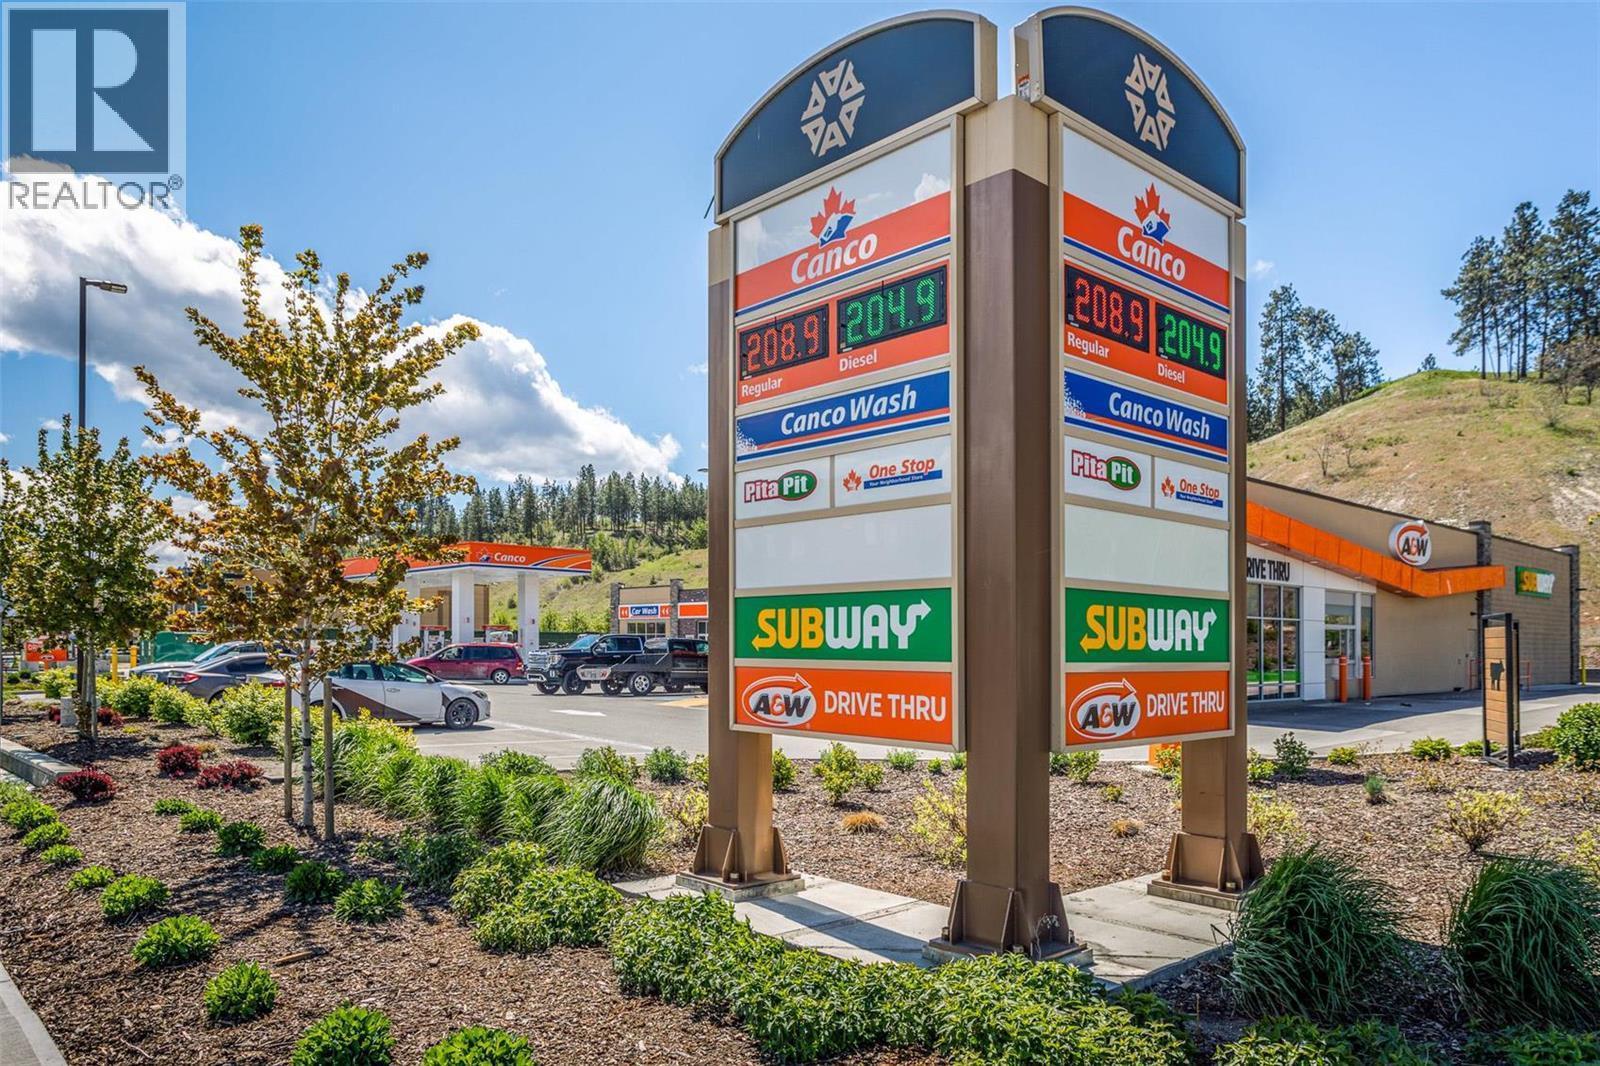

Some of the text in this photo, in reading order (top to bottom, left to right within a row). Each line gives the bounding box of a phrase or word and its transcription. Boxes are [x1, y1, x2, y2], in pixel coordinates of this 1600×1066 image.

[791, 233, 878, 285] Canco
[1117, 226, 1186, 282] Canco
[846, 277, 936, 344] 204.9
[1075, 278, 1144, 343] 208.9
[747, 314, 819, 371] 208.9
[1067, 331, 1110, 359] Regular
[1164, 313, 1221, 371] 204.9
[839, 349, 878, 372] Diesel
[1158, 363, 1185, 384] Diesel
[741, 376, 783, 398] Regular
[781, 384, 917, 436] Canco Wash
[1109, 392, 1210, 440] Canco Wash
[869, 458, 935, 479] One Stop
[1180, 478, 1197, 494] One
[1200, 483, 1220, 499] Stop
[494, 552, 526, 563] Canco
[1401, 536, 1428, 557] A&W
[1246, 557, 1290, 582] RIVE THRU
[642, 607, 657, 615] Wash
[752, 599, 932, 651] SUBWAY
[1080, 604, 1217, 653] SUBWAY
[753, 690, 946, 722] A&W DRIVE THRU
[1080, 691, 1225, 729] A&W DRIVE THRU
